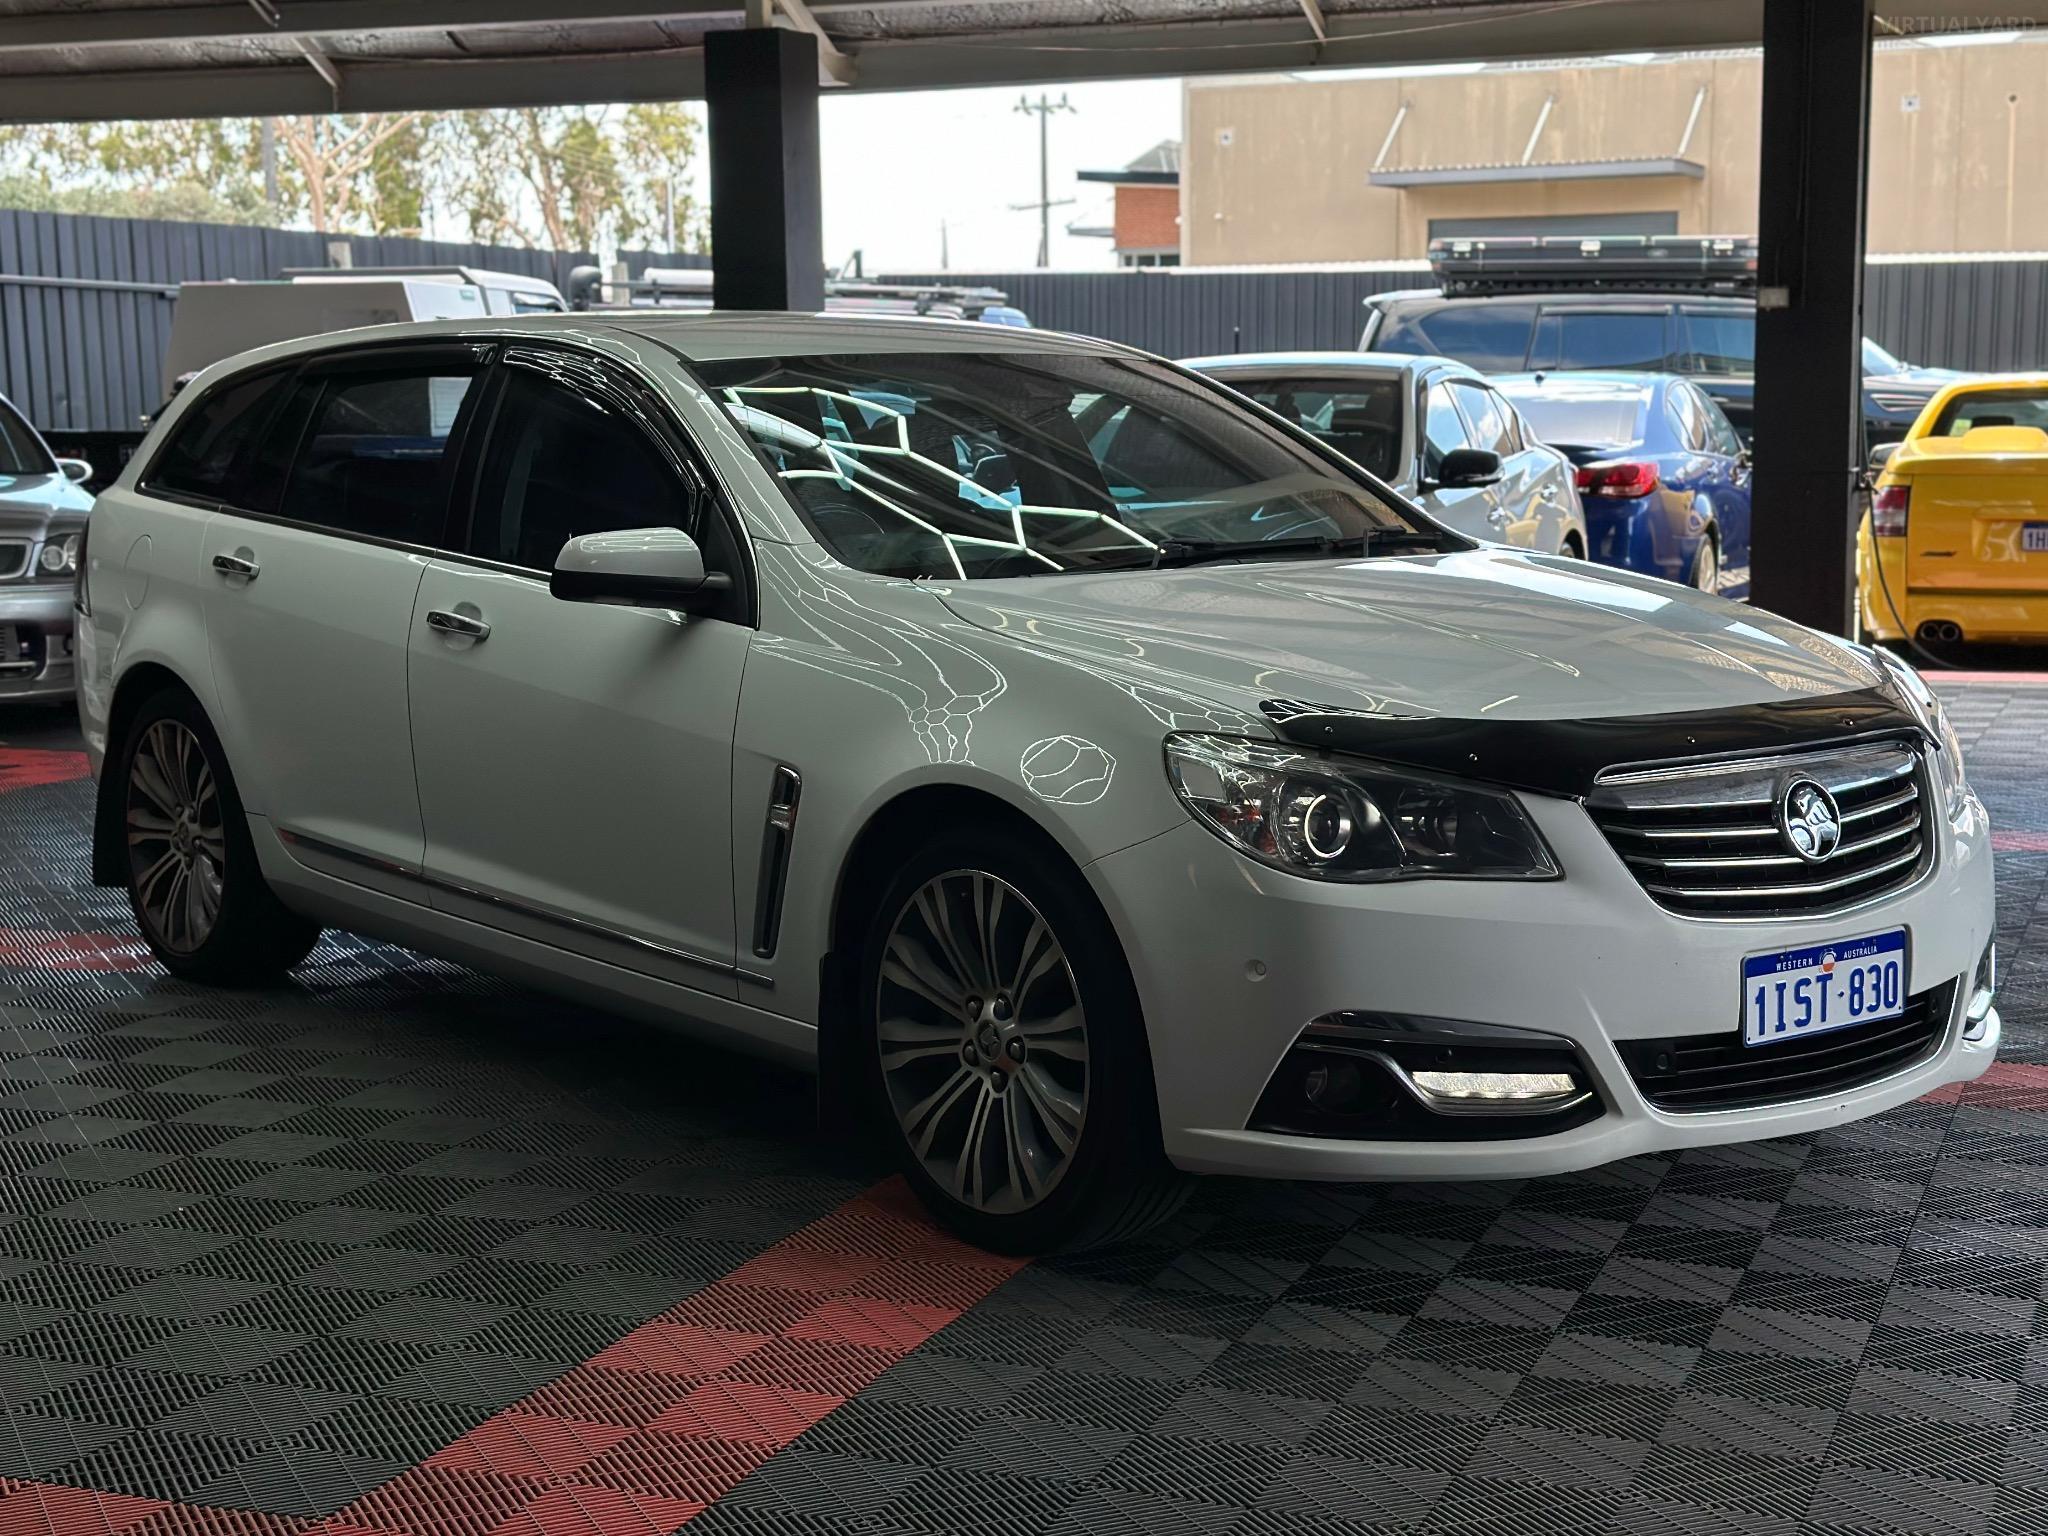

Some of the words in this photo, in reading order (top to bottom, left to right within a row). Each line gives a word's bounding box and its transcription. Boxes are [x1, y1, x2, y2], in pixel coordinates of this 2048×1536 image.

[2028, 531, 2048, 549] 1H
[1775, 958, 1813, 971] WESTERN
[1843, 945, 1878, 959] AUSTRALIA
